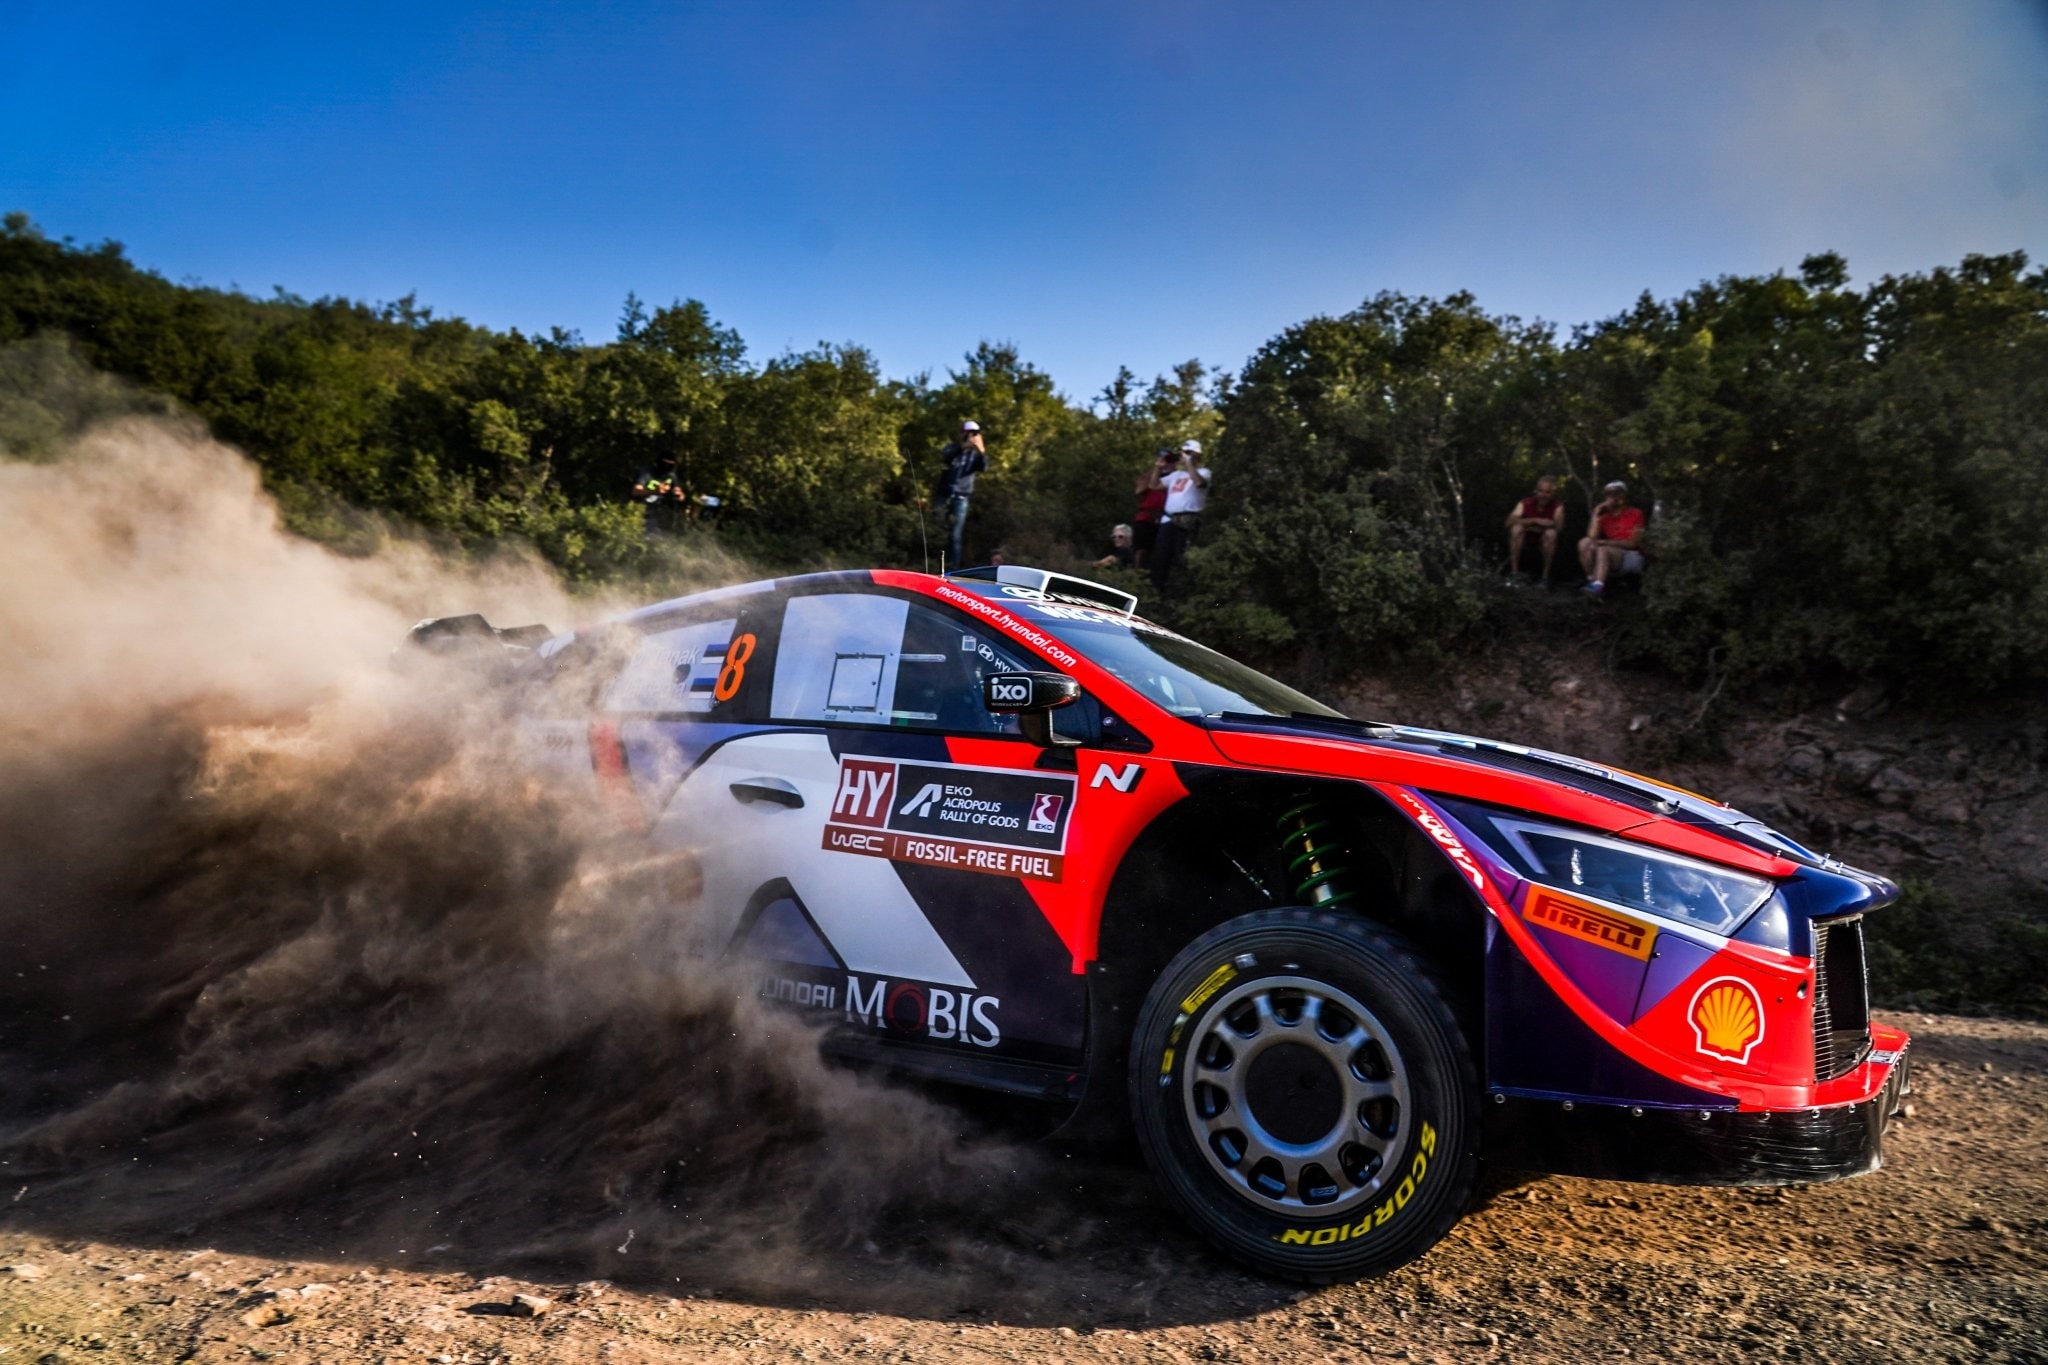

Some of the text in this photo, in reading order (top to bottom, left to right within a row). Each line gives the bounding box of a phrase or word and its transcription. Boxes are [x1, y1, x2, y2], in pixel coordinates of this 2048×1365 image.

[935, 585, 1077, 668] motorsport.hyundai.com
[715, 633, 757, 701] 8
[834, 768, 892, 818] HY
[942, 797, 1002, 813] ACROPOLIS
[945, 785, 973, 797] EKO
[939, 809, 1020, 829] RALLY OF GODS
[1035, 823, 1053, 831] EKO
[831, 831, 885, 852] WRC
[905, 840, 1054, 877] FOSSIL-FREE FUEL
[1532, 893, 1647, 951] PIRELLI
[762, 975, 1001, 1048] UNDAI MOBIS
[1279, 1119, 1437, 1246] SCORPION
